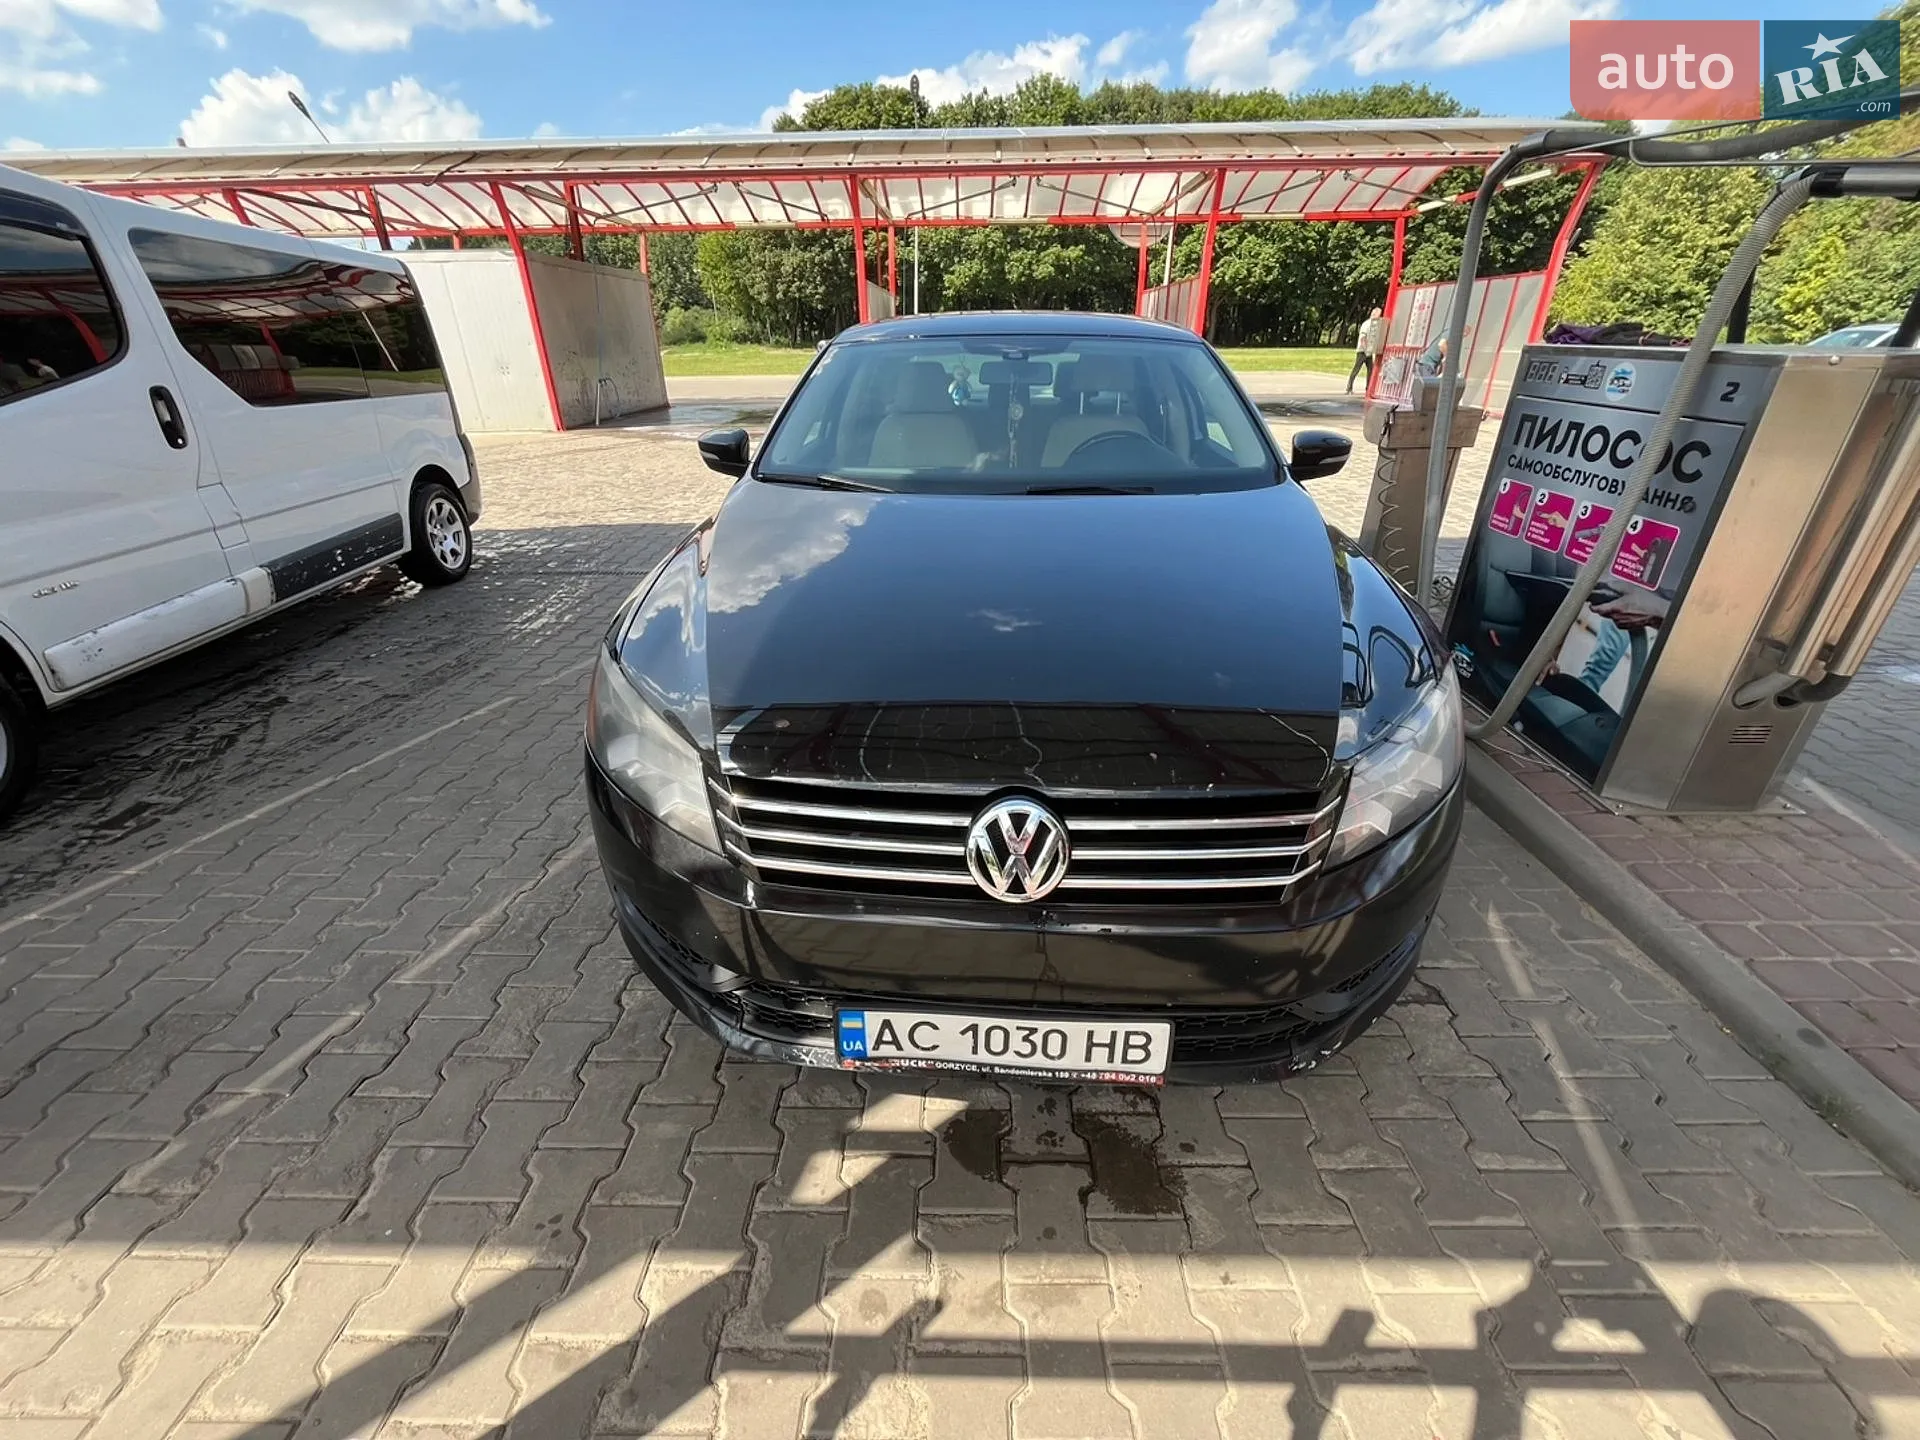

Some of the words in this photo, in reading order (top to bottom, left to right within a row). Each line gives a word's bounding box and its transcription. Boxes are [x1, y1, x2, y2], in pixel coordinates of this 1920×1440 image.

[1719, 381, 1740, 402] 2
[1508, 454, 1695, 512] САМООБСЛУГОВУАННЯ
[1538, 493, 1546, 503] 2
[1580, 505, 1589, 516] 3
[1630, 520, 1640, 532] 4
[843, 1040, 864, 1051] UA
[872, 1018, 940, 1052] AC
[959, 1023, 1068, 1061] 1030
[1084, 1029, 1152, 1065] HB
